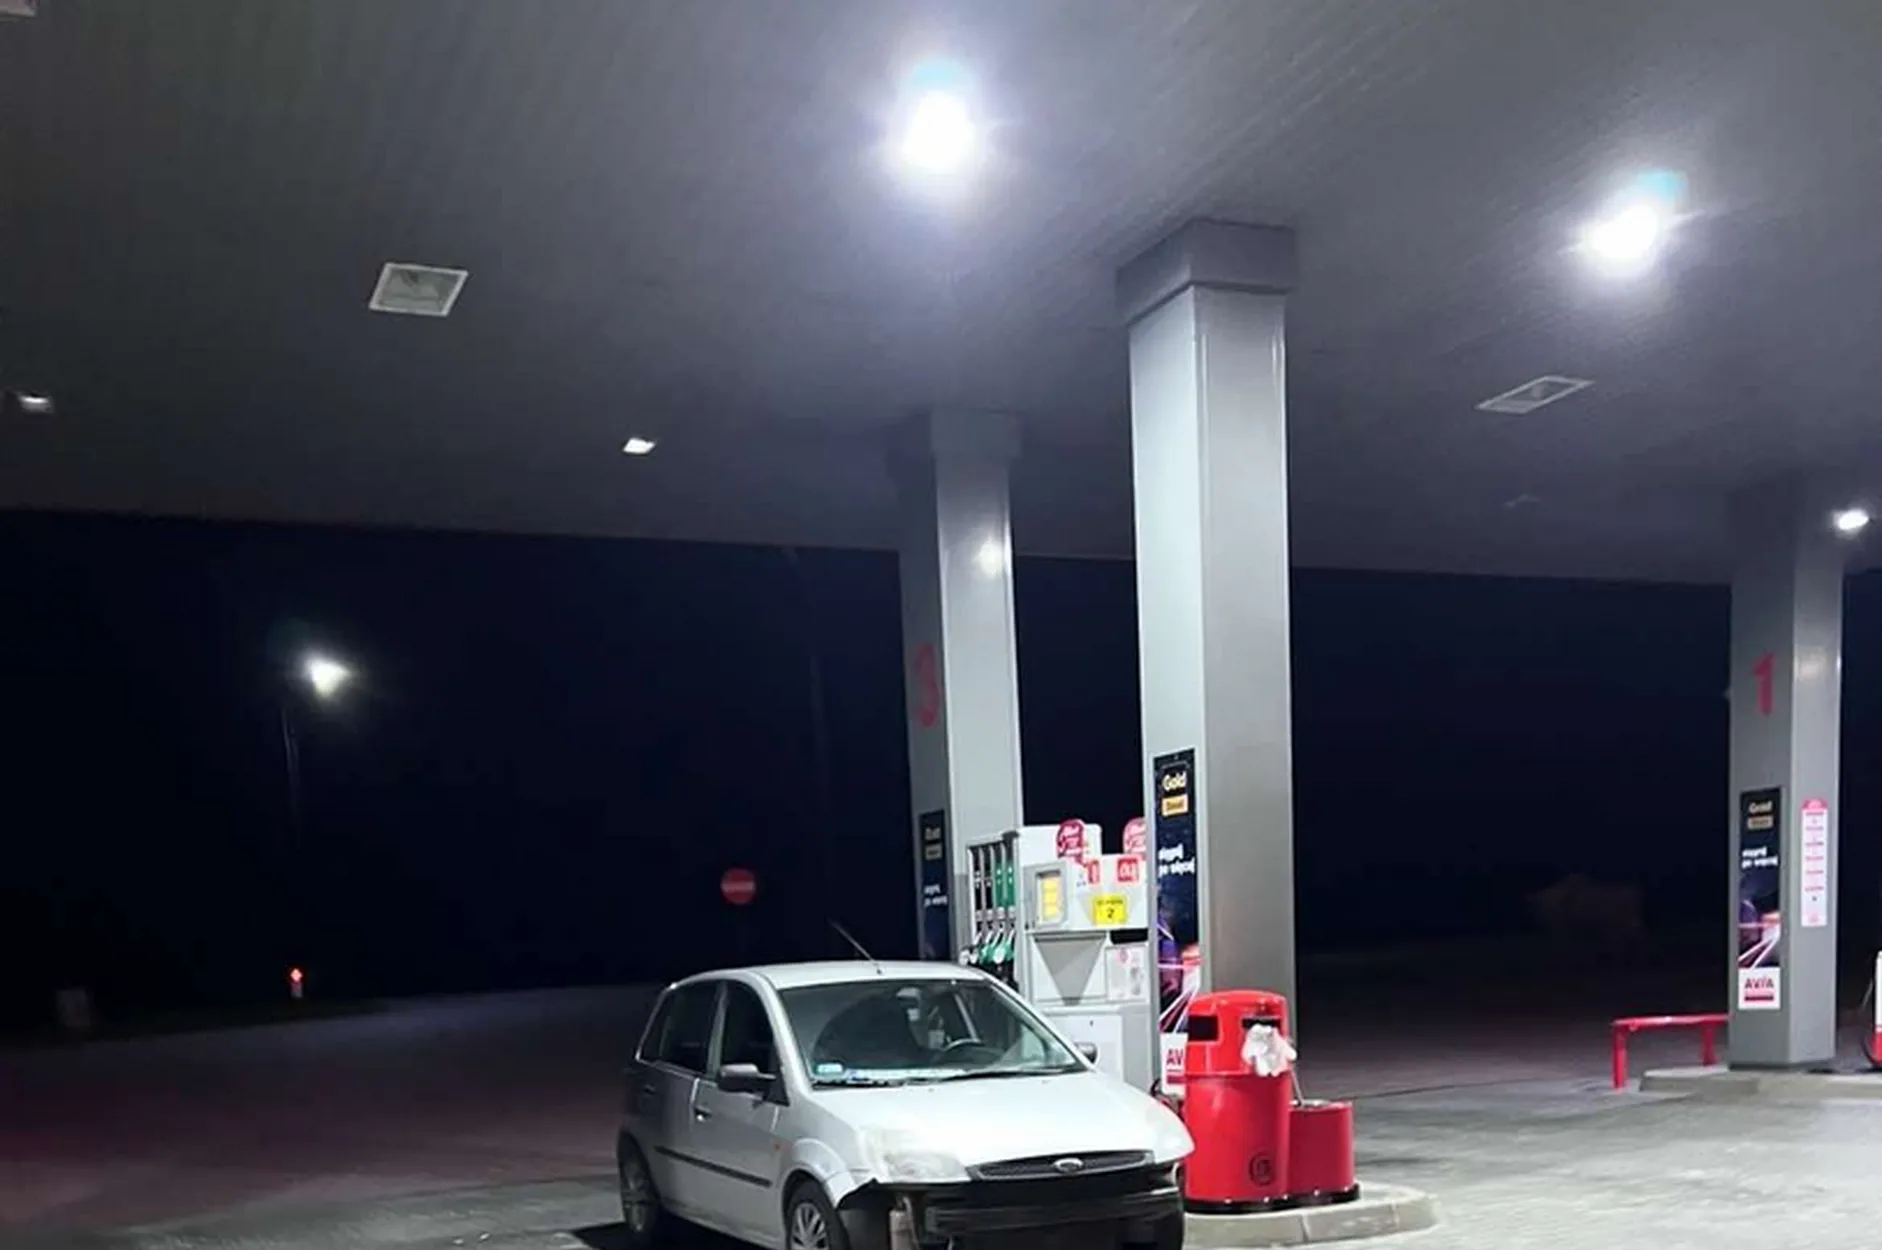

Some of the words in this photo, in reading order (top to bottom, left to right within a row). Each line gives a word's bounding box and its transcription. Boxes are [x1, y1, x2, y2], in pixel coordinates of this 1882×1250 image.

[1752, 652, 1775, 714] 1
[1162, 772, 1187, 790] Gold
[1745, 977, 1774, 988] AVIA
[1166, 1048, 1184, 1066] AV
